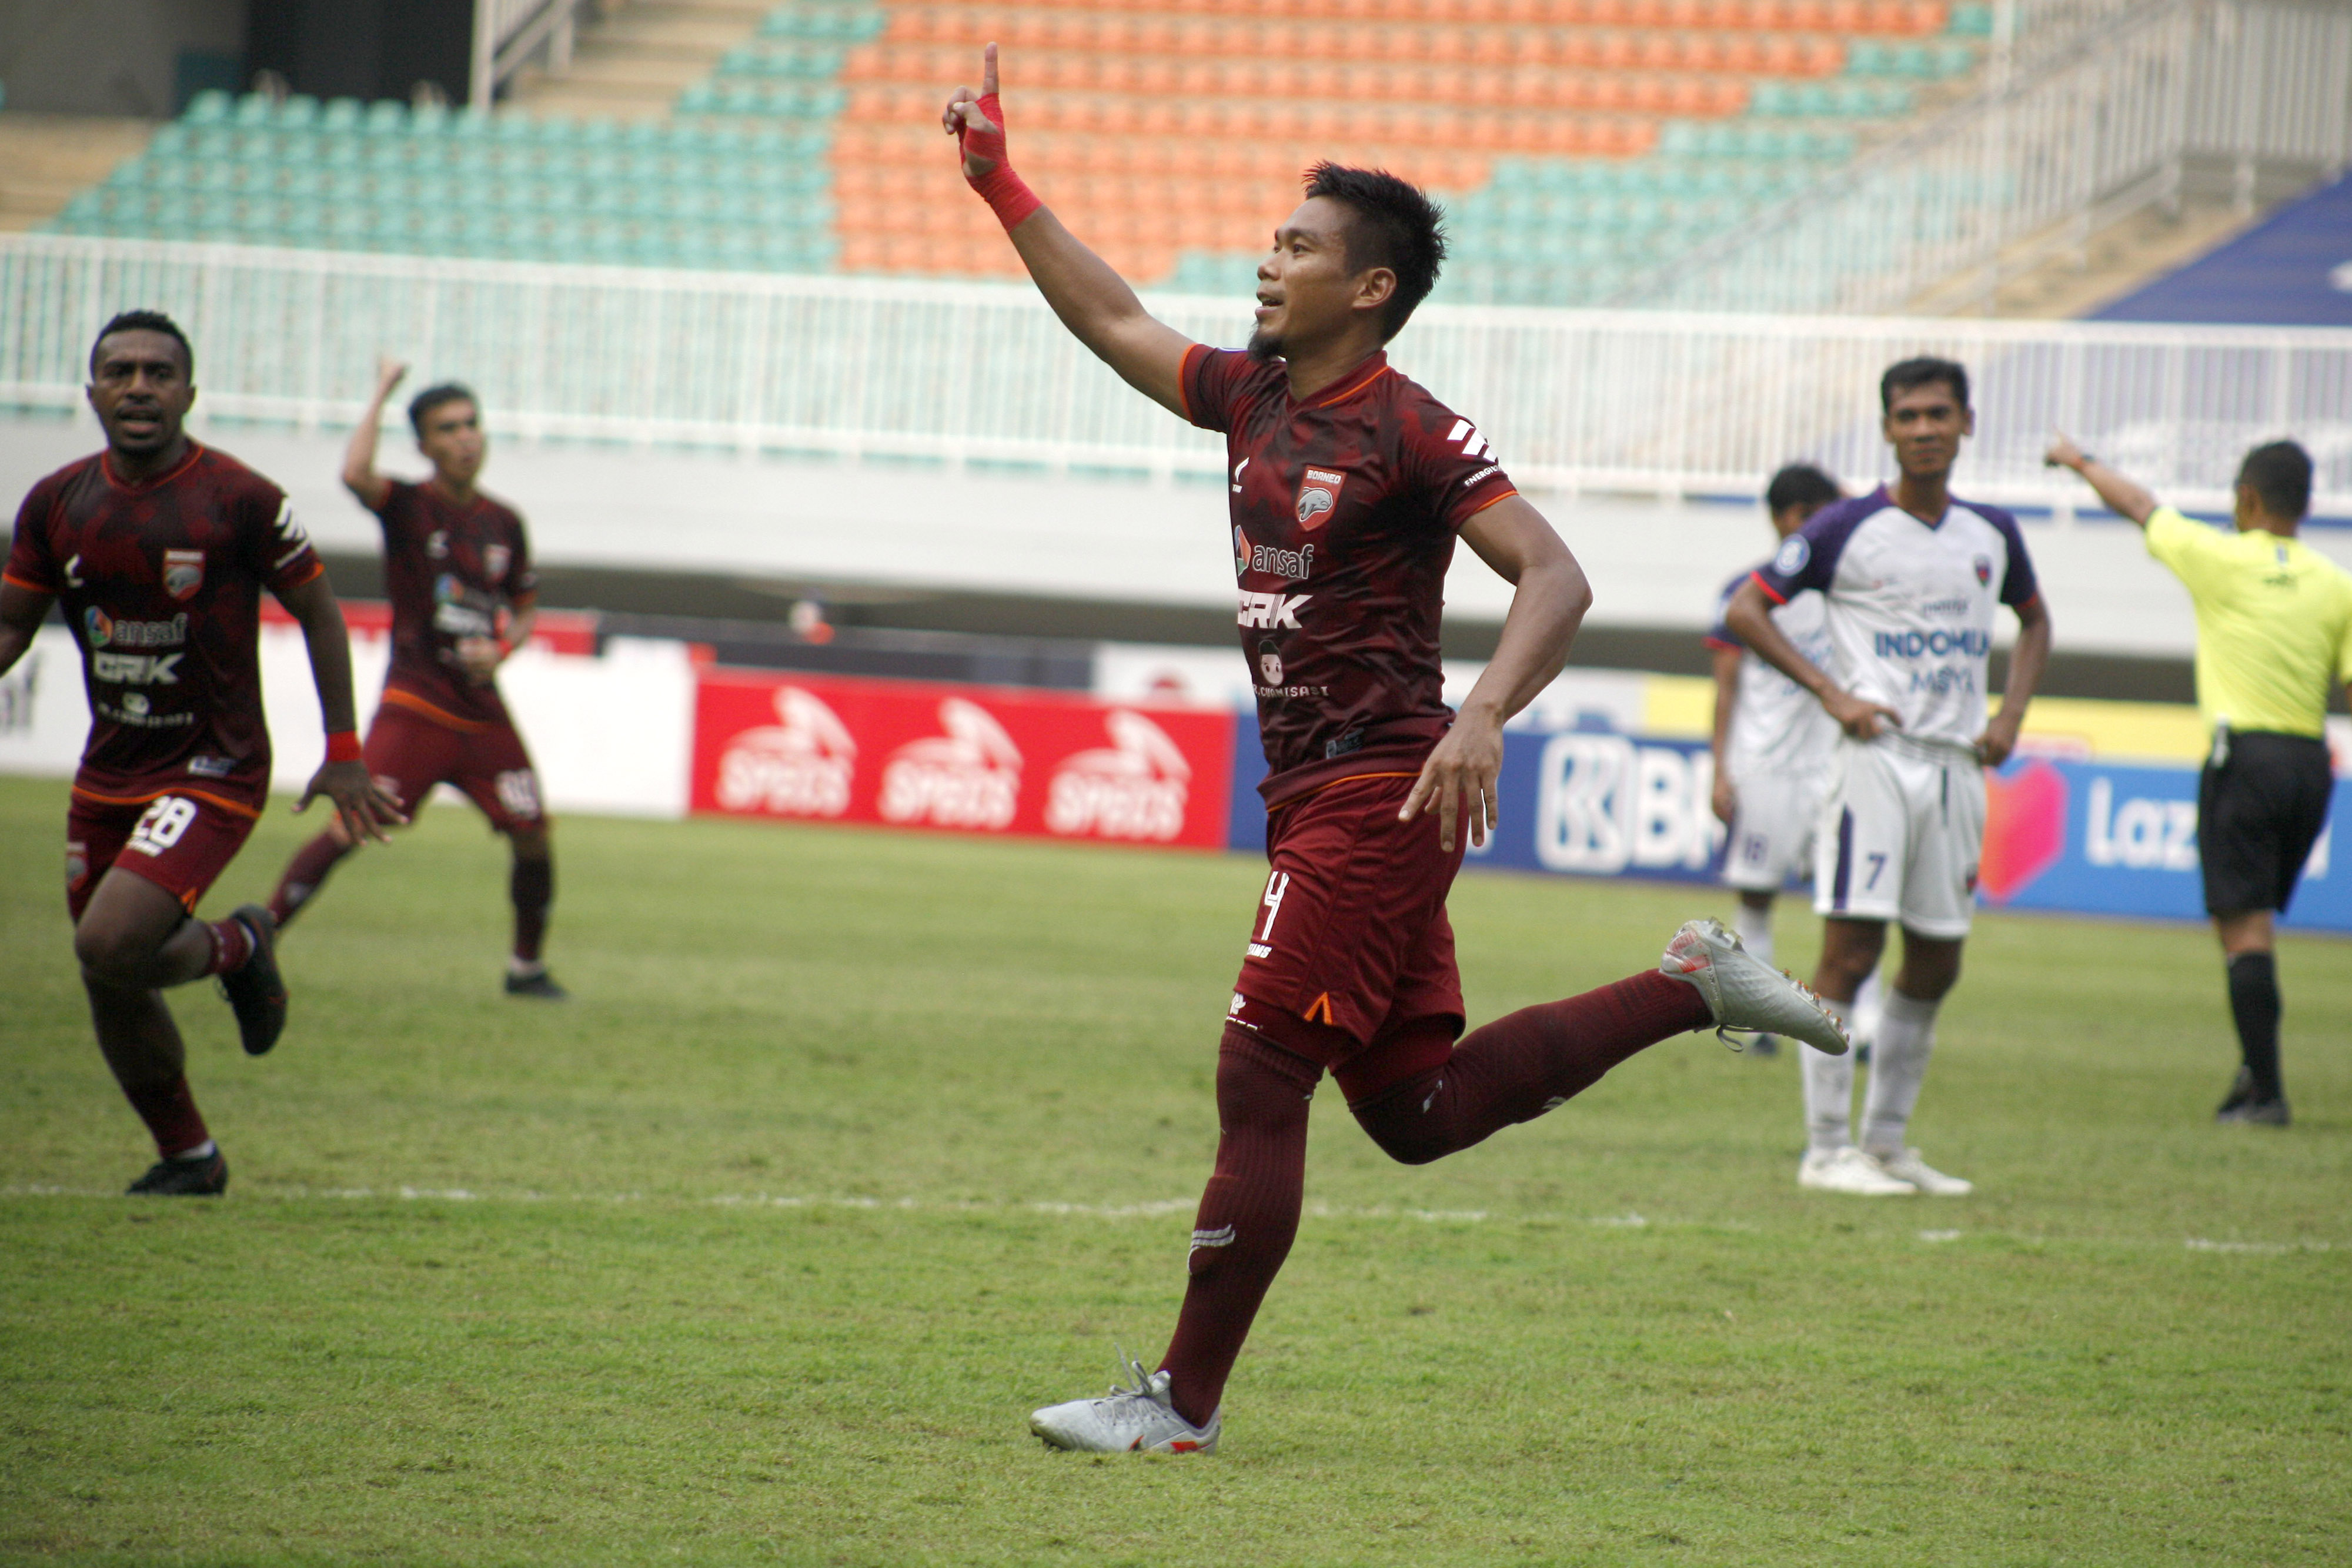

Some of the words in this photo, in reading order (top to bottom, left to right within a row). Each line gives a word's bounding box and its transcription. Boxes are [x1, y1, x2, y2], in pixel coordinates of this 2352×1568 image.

[1306, 469, 1342, 485] BORNEO
[132, 795, 198, 848] 28
[1866, 853, 1887, 891] 7
[1264, 870, 1290, 941] 4
